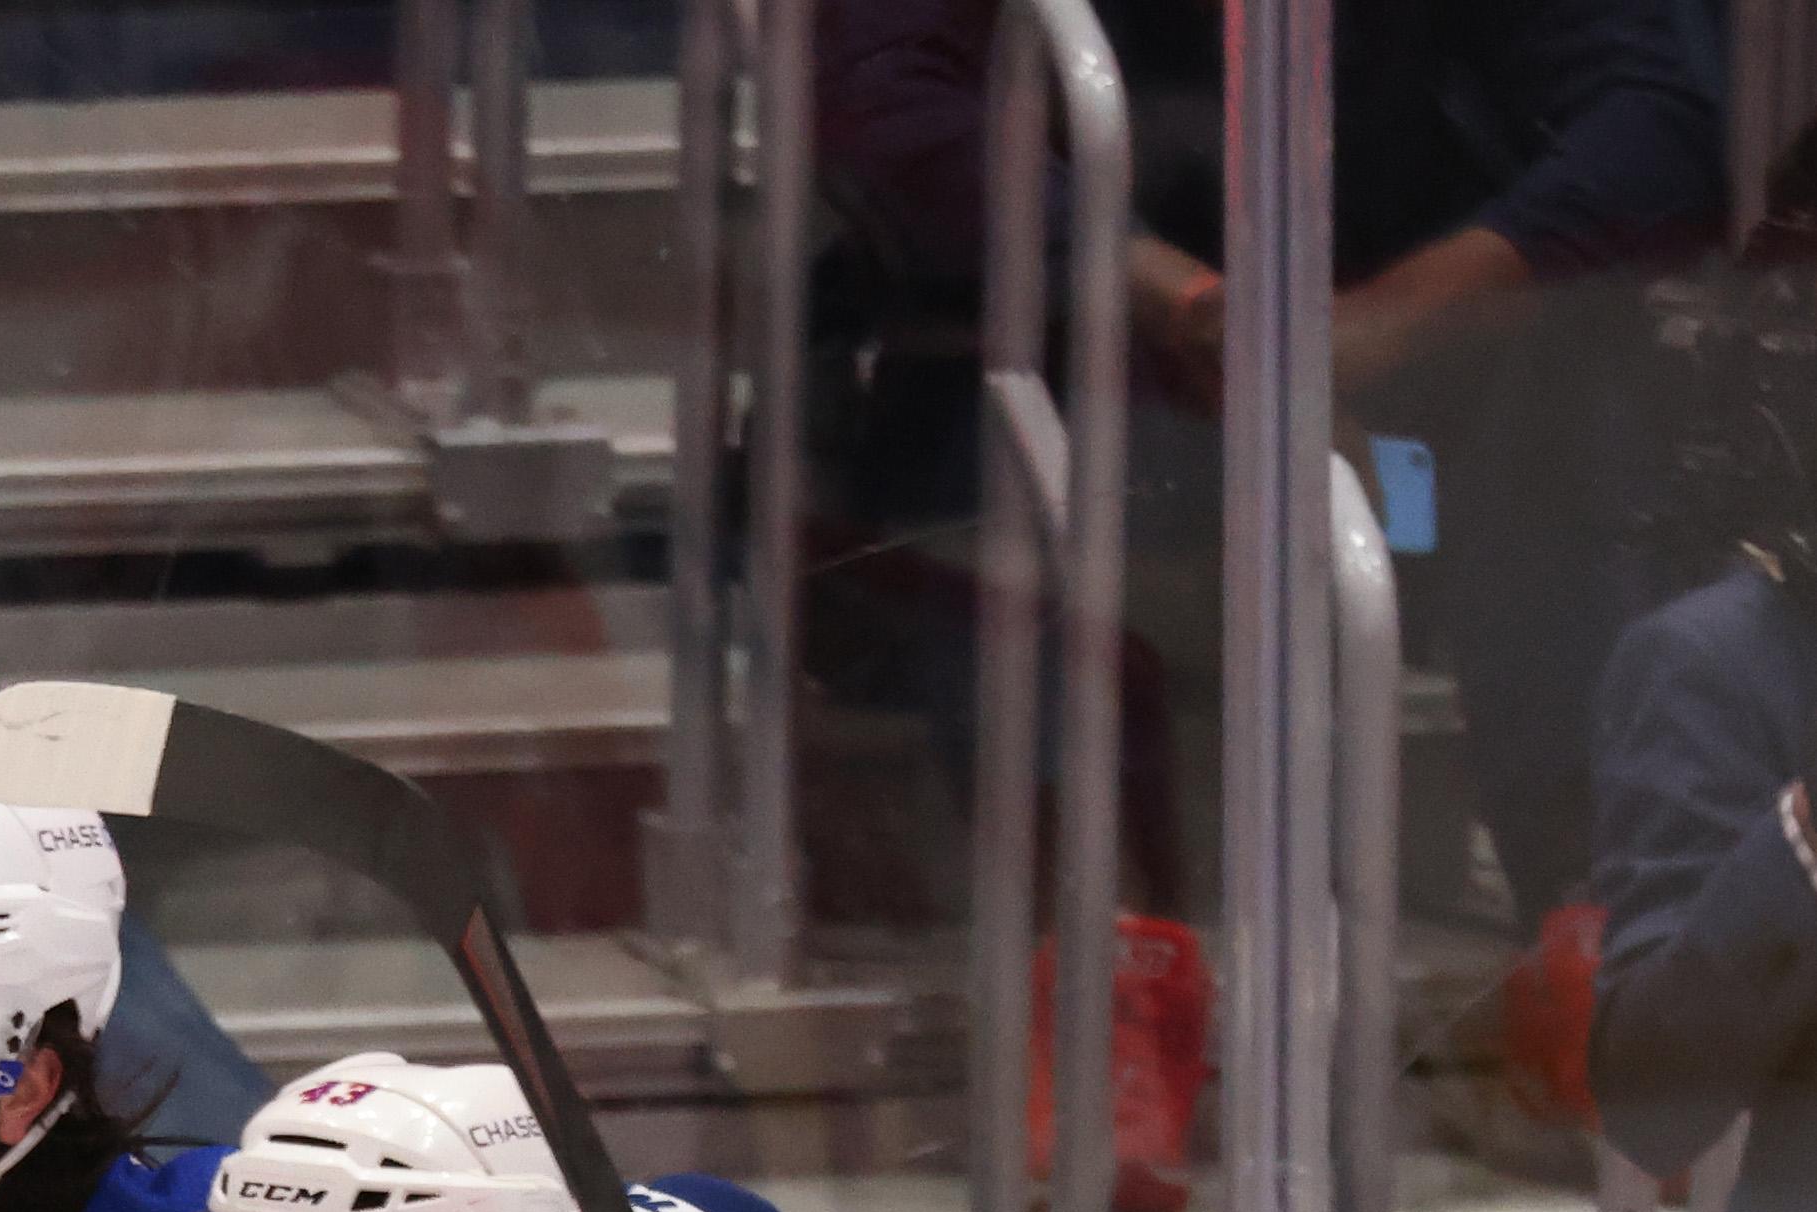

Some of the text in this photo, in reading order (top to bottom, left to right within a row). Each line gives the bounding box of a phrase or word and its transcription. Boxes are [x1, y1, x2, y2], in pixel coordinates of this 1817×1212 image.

[38, 825, 103, 852] CHASE
[299, 1081, 376, 1107] 43
[239, 1181, 328, 1206] CCM
